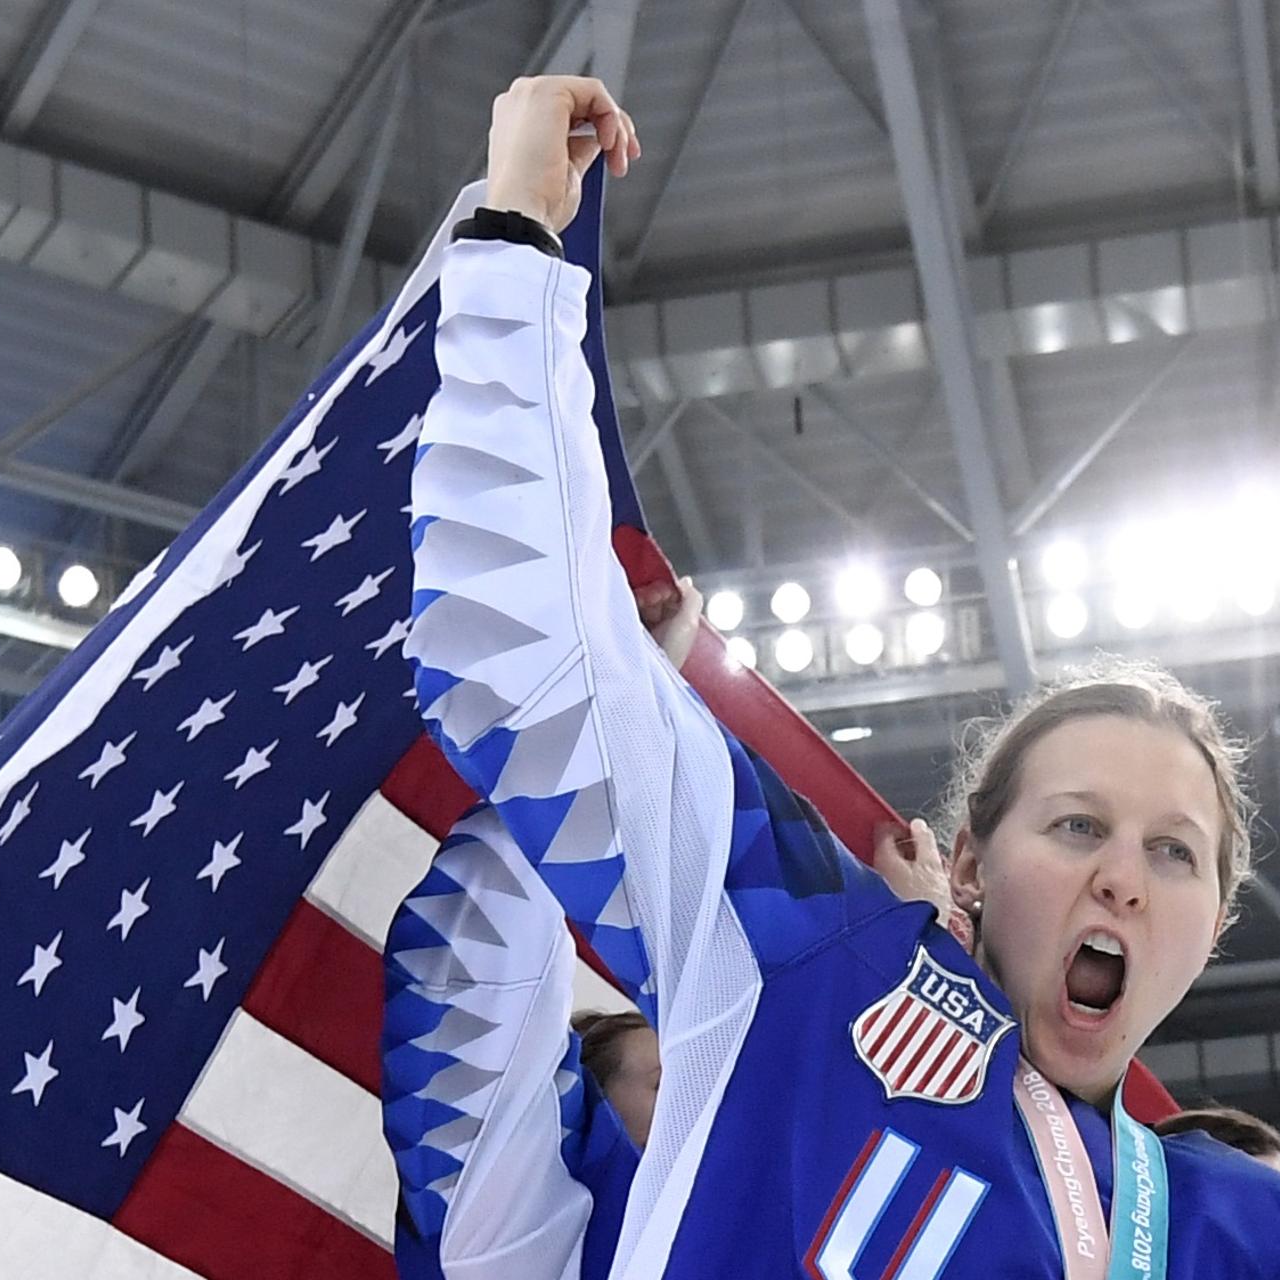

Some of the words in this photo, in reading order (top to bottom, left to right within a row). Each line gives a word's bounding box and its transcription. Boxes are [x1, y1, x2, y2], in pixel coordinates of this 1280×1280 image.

[920, 972, 986, 1034] USA
[1022, 1069, 1056, 1112] 2018
[1045, 1113, 1096, 1259] PyeongChang
